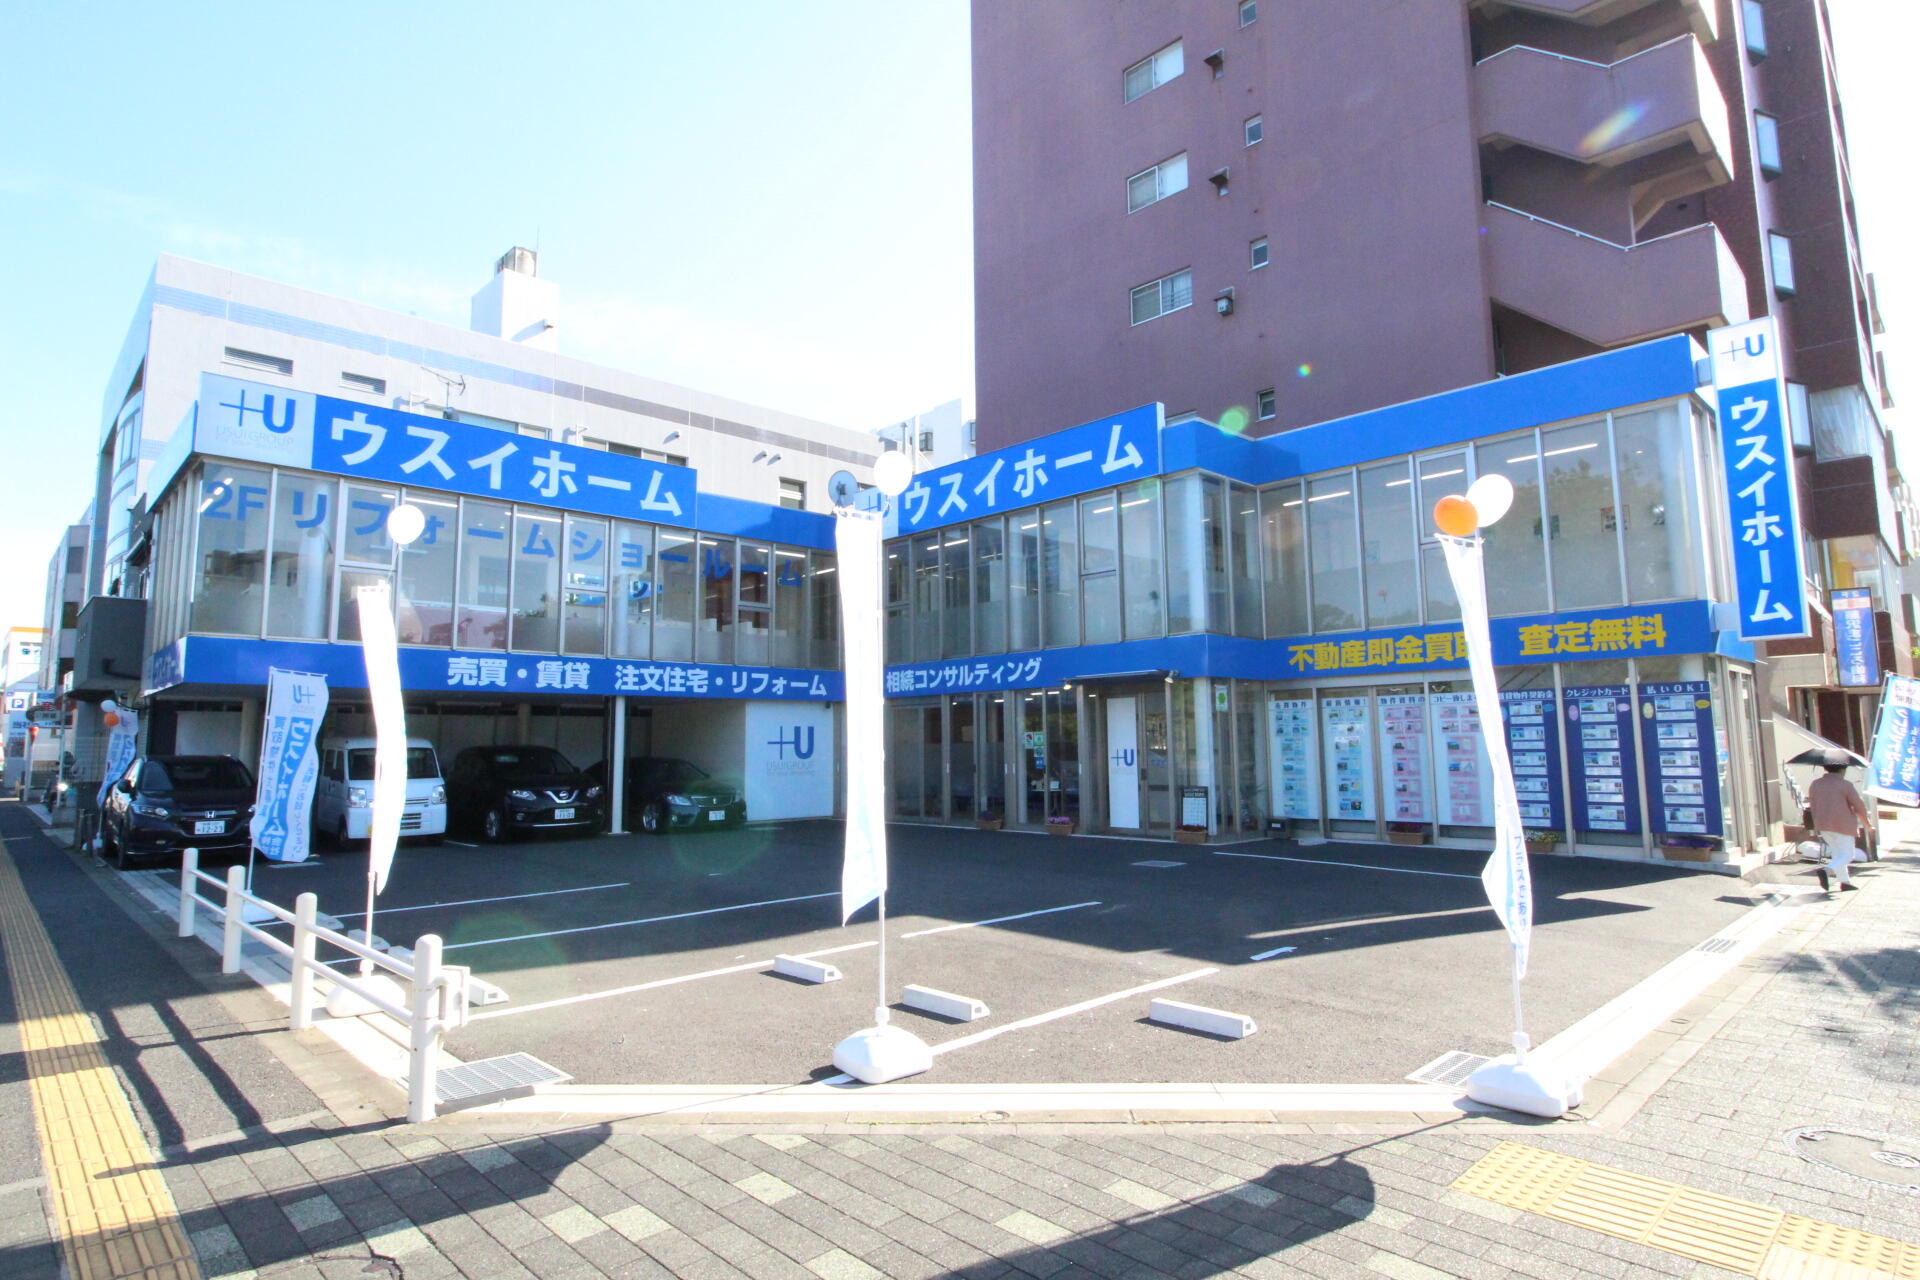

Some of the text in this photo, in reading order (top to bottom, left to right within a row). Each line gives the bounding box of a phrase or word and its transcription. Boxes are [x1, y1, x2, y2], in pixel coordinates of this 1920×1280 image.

[331, 410, 682, 517] ウスイホーム
[904, 424, 1144, 525] ウスイホーム
[1731, 395, 1793, 623] ウスイホーム
[1518, 613, 1667, 656] 査定無料
[447, 656, 827, 697] 売買・賃貸 注文住宅・リフォーム
[886, 656, 1043, 692] 相続コンサルティング
[1566, 687, 1630, 698] クレジットカード
